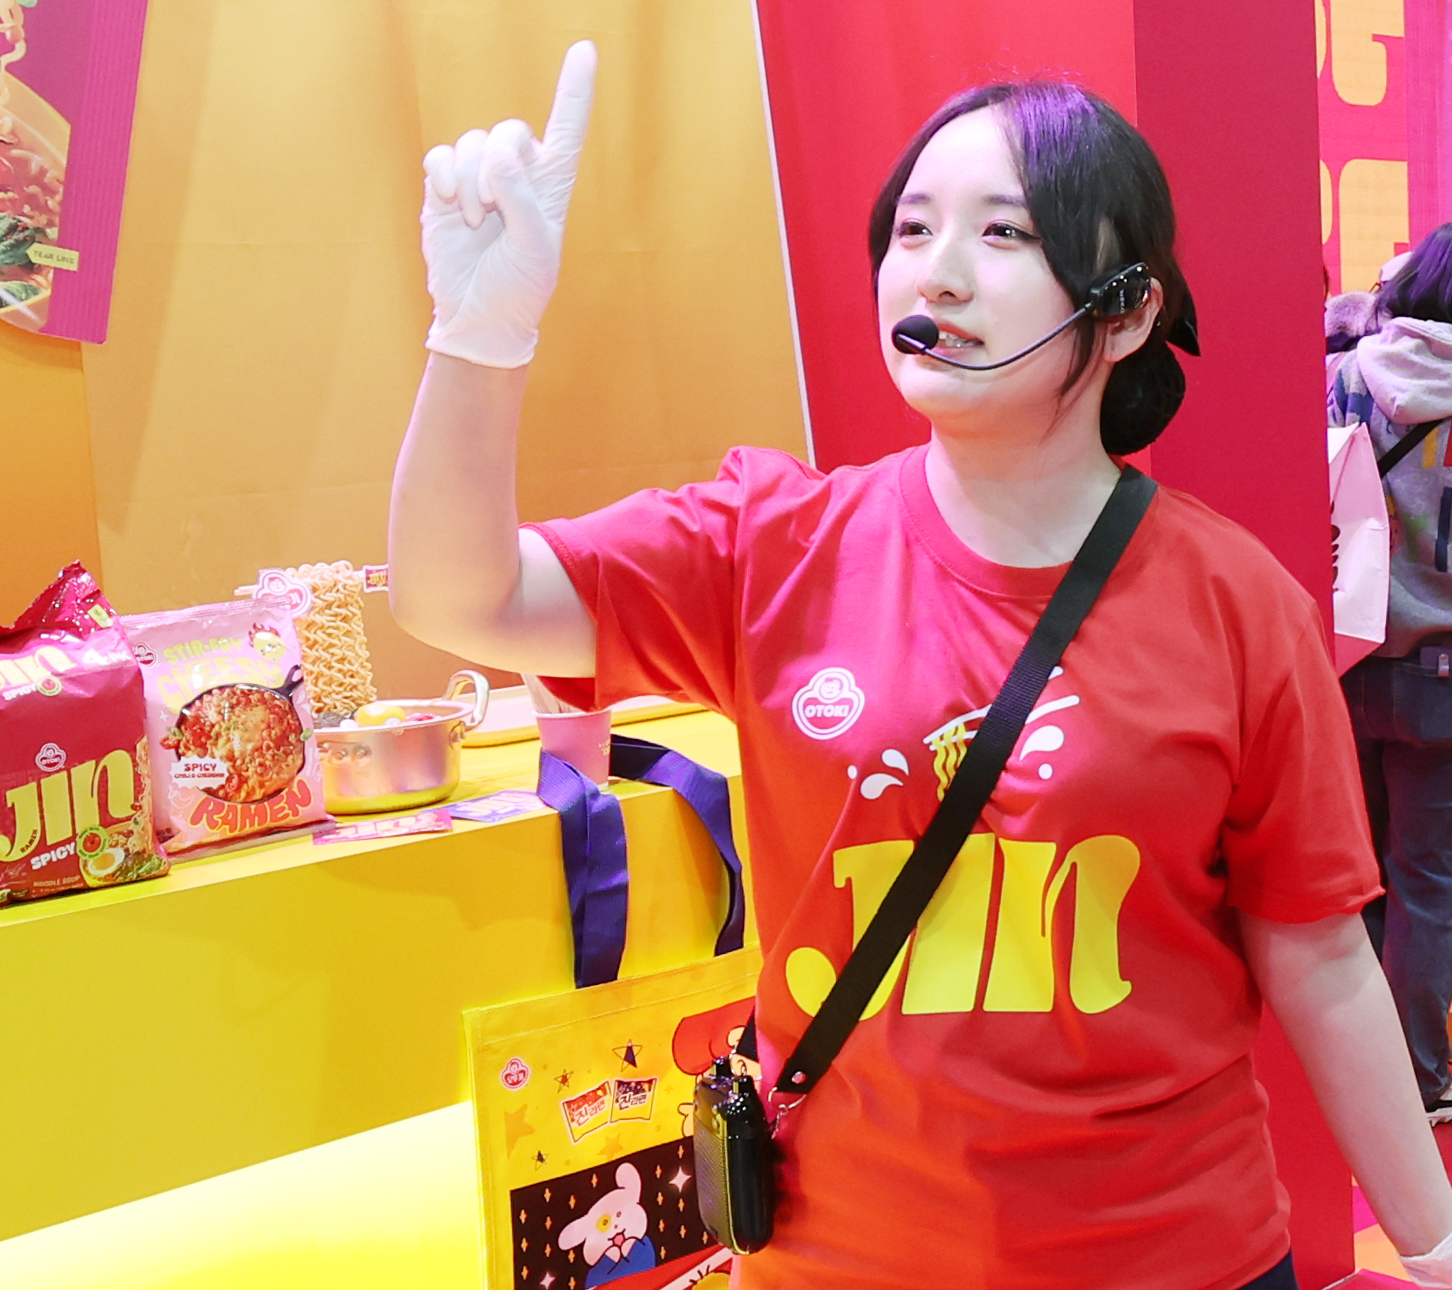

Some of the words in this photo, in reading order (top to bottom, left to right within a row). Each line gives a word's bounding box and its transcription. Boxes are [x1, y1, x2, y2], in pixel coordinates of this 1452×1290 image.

[162, 638, 244, 662] STIR-FRY
[2, 685, 37, 701] SPICY
[804, 703, 850, 719] OTOKI
[184, 763, 217, 772] SPICY
[190, 779, 312, 834] RAMEN
[30, 842, 76, 871] SPICY
